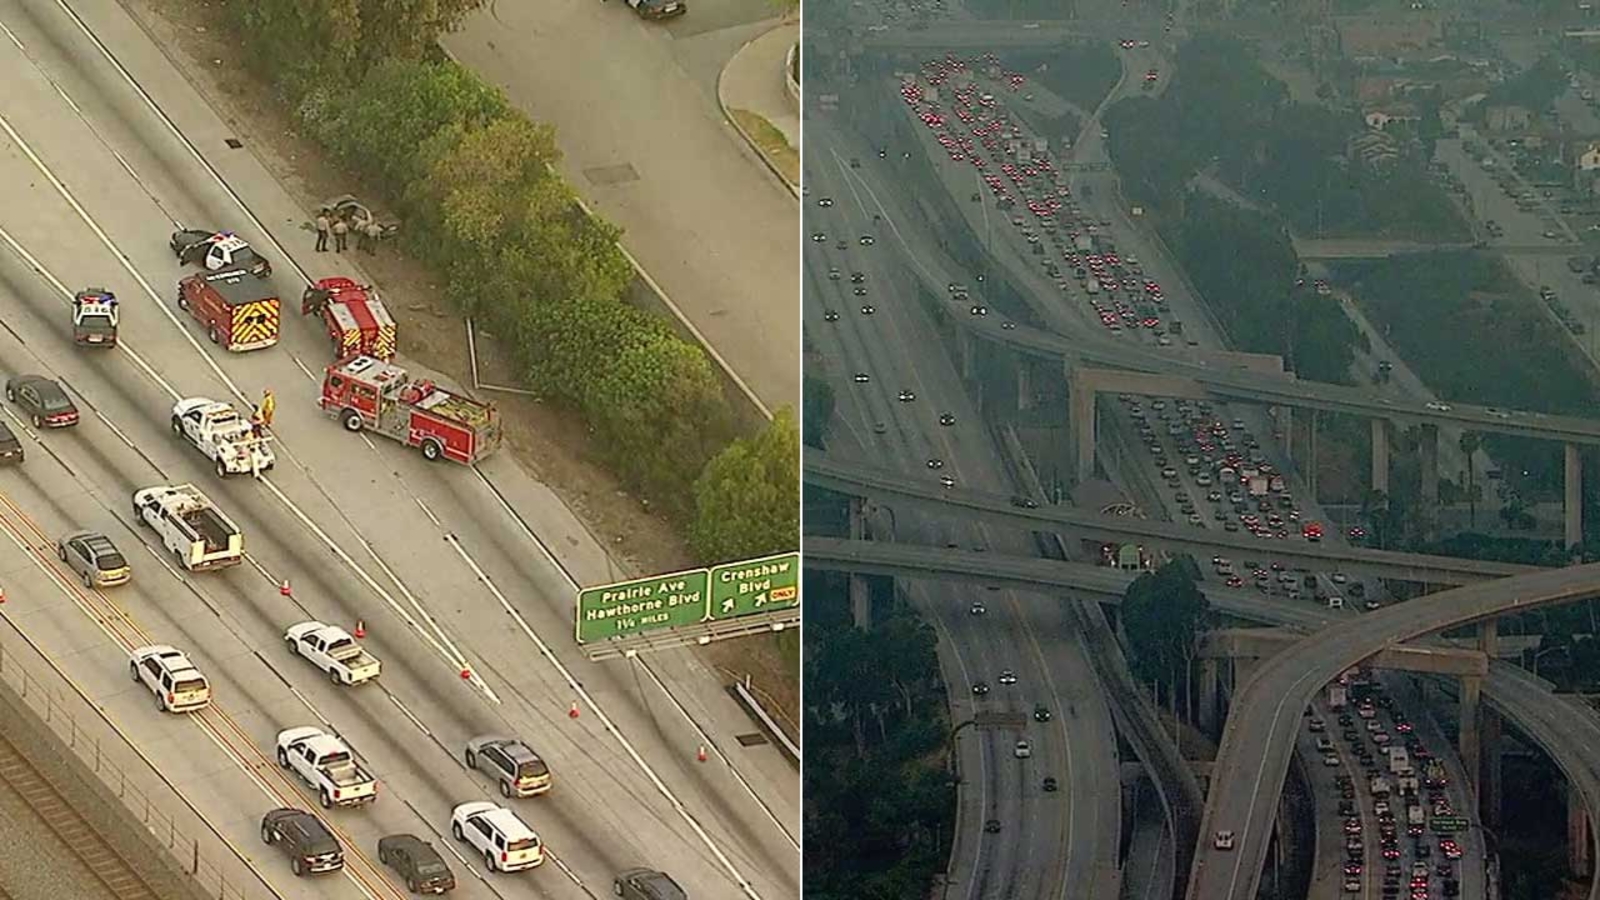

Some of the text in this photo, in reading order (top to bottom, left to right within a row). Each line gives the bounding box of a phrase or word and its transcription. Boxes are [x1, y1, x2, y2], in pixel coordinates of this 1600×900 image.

[721, 563, 790, 582] Crenshaw
[602, 581, 686, 603] Prairie Ave
[739, 579, 771, 594] Blvd
[772, 589, 794, 599] ONLY
[586, 591, 701, 621] Hawthorne Blvd
[640, 612, 669, 624] MILES
